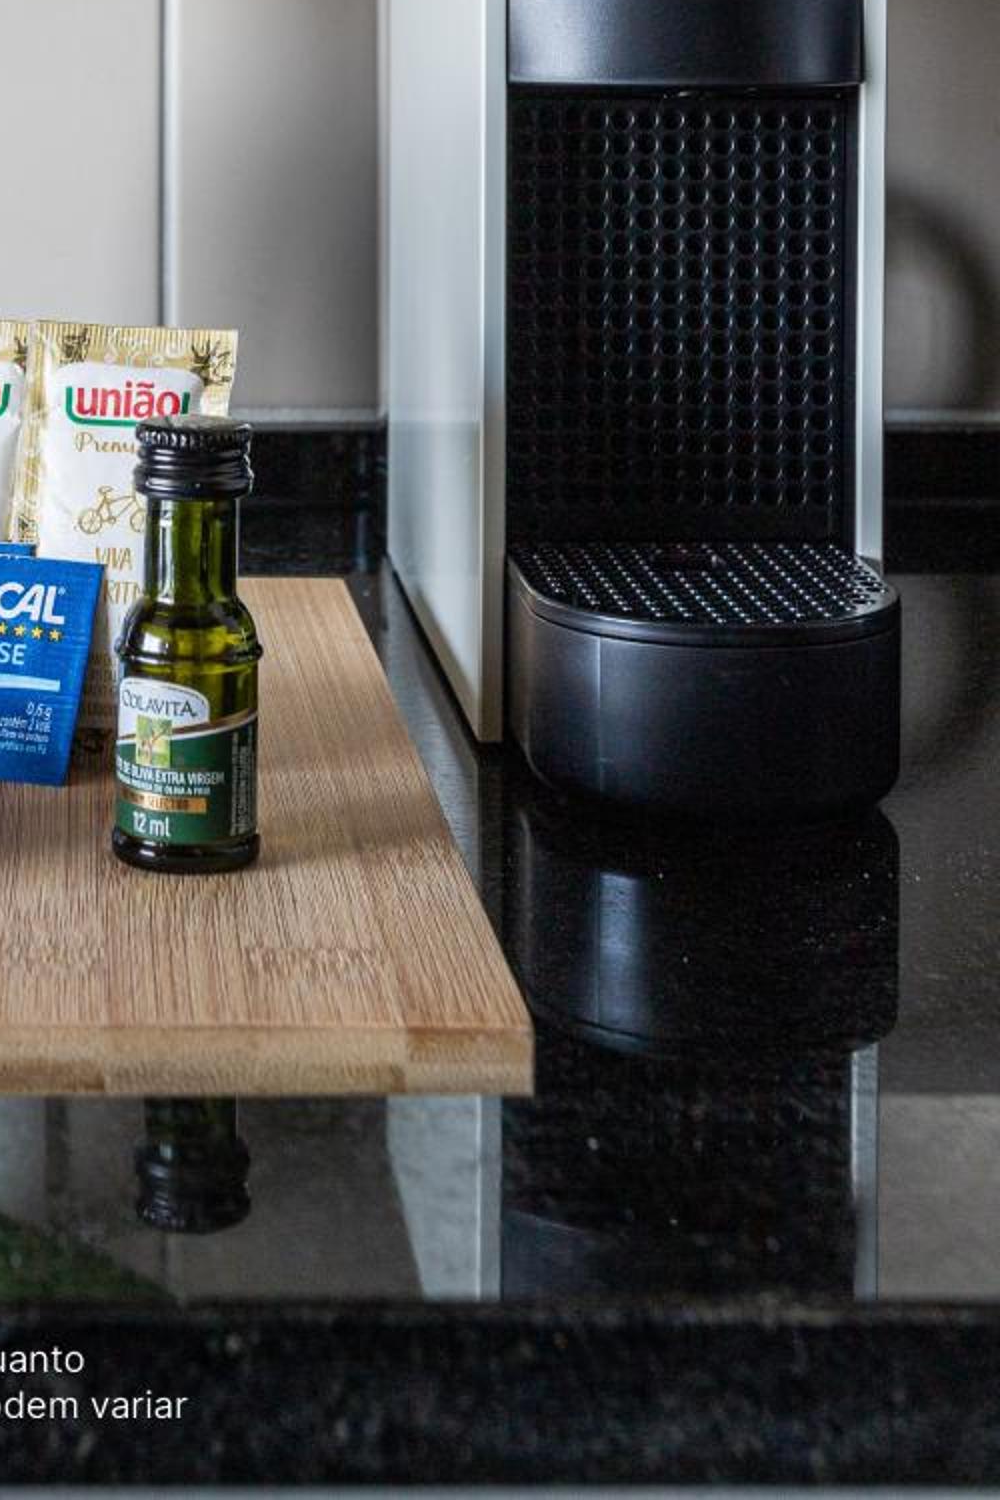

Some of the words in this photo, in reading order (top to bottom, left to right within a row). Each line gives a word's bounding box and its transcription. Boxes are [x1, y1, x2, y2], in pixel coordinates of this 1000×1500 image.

[75, 380, 182, 419] união
[74, 431, 139, 454] Premi
[121, 689, 198, 718] COLAVITA
[155, 769, 186, 785] EXTRA
[187, 771, 226, 786] VIRGEM
[132, 811, 148, 832] 12
[149, 816, 172, 838] ml
